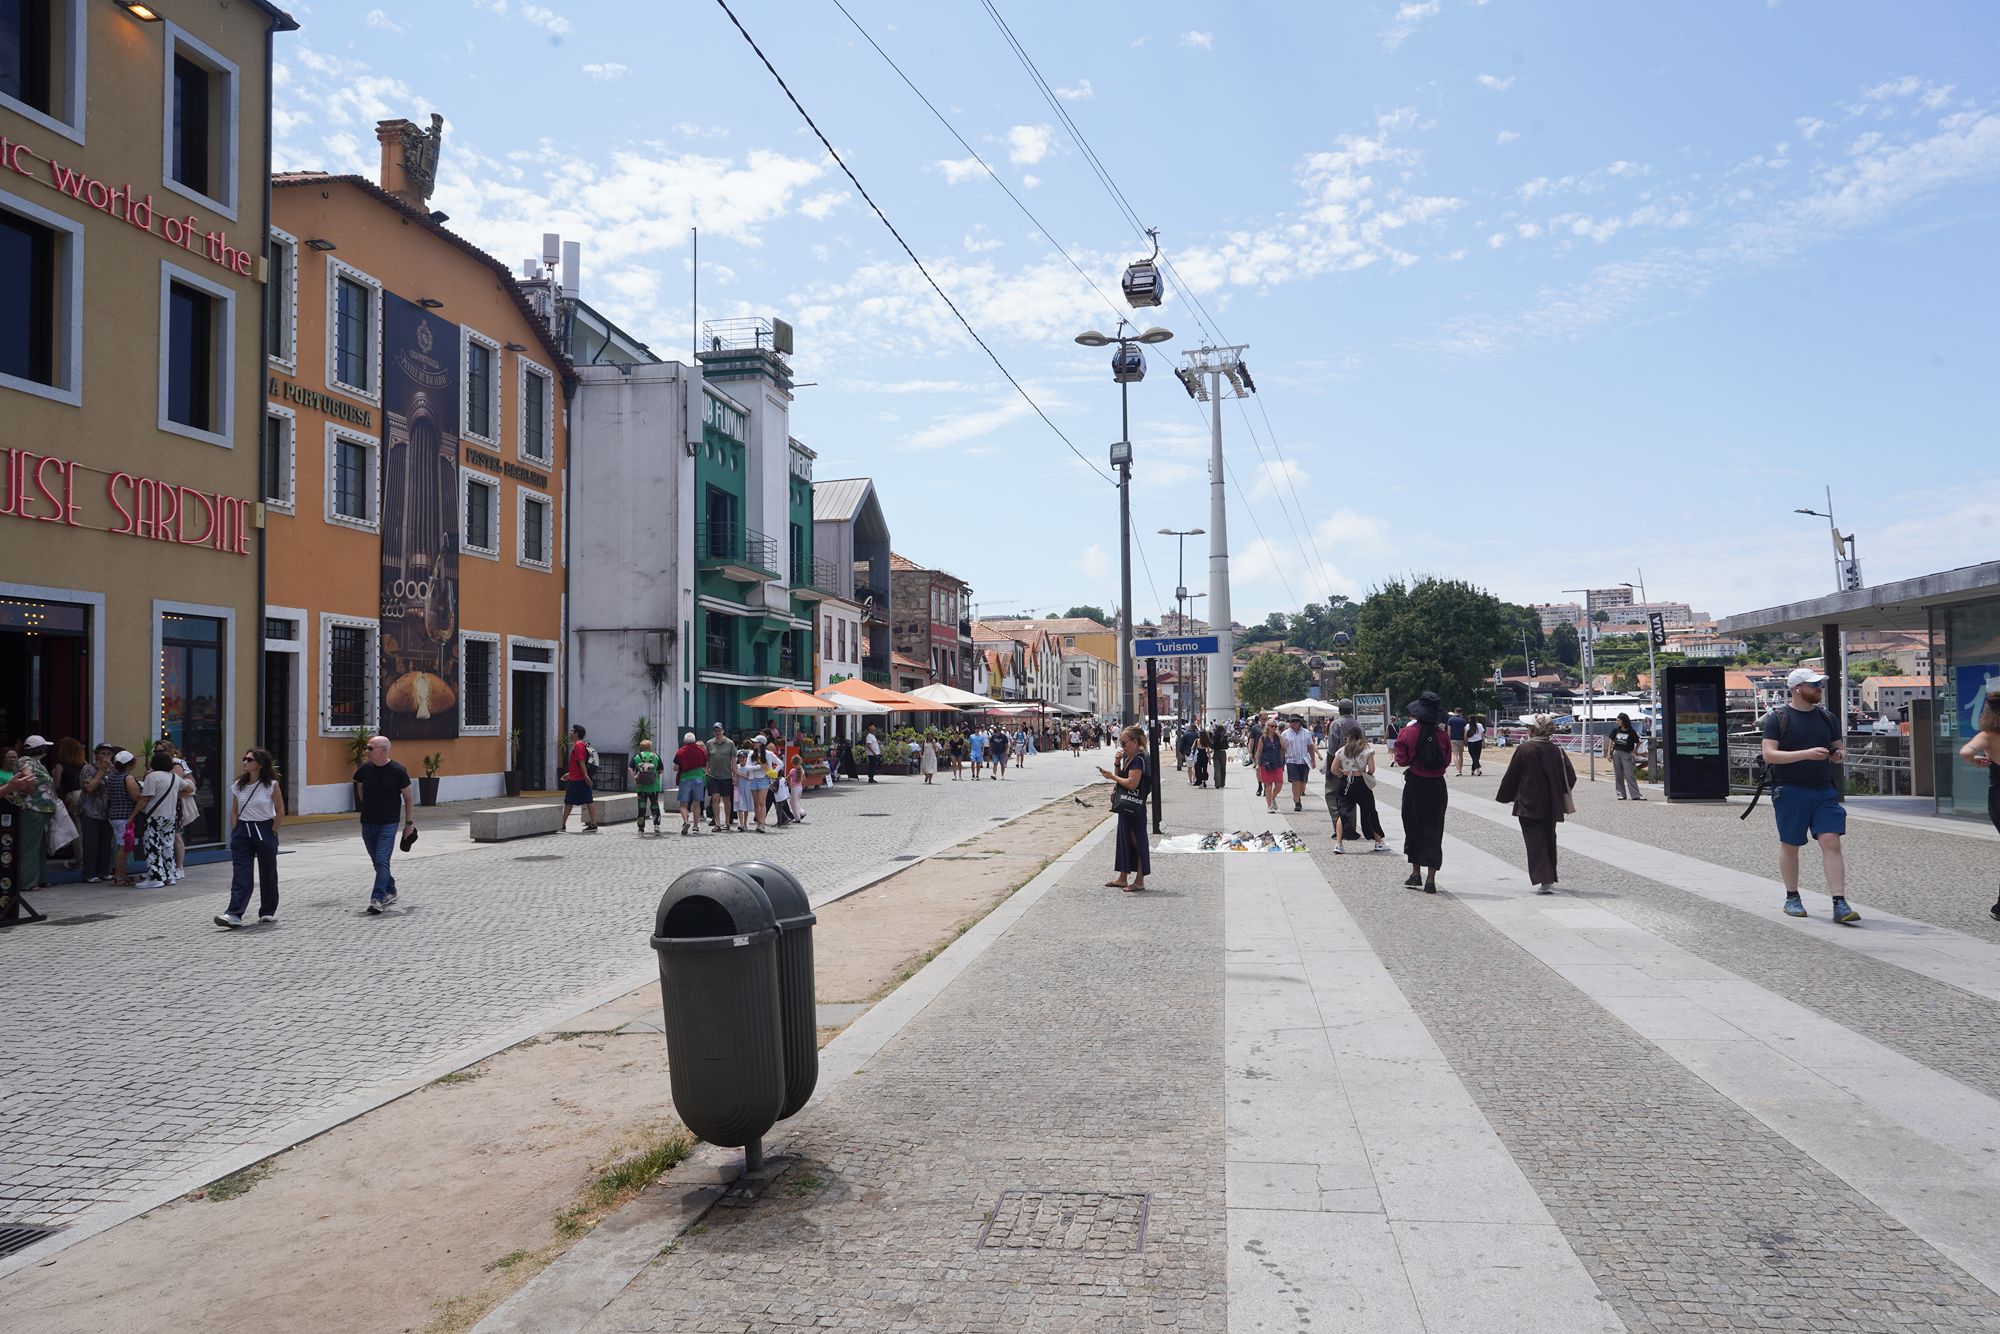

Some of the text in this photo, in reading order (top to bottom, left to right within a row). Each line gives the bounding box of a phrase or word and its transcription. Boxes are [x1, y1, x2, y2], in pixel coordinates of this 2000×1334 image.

[50, 160, 151, 231] world
[163, 215, 198, 250] of
[207, 231, 252, 276] the
[284, 381, 373, 428] PORTUGUESA
[466, 447, 501, 473] PASTEL
[108, 470, 250, 556] SARDINE
[1653, 616, 1664, 643] GAIA
[1156, 642, 1199, 652] Turismo
[1356, 697, 1383, 705] WOW
